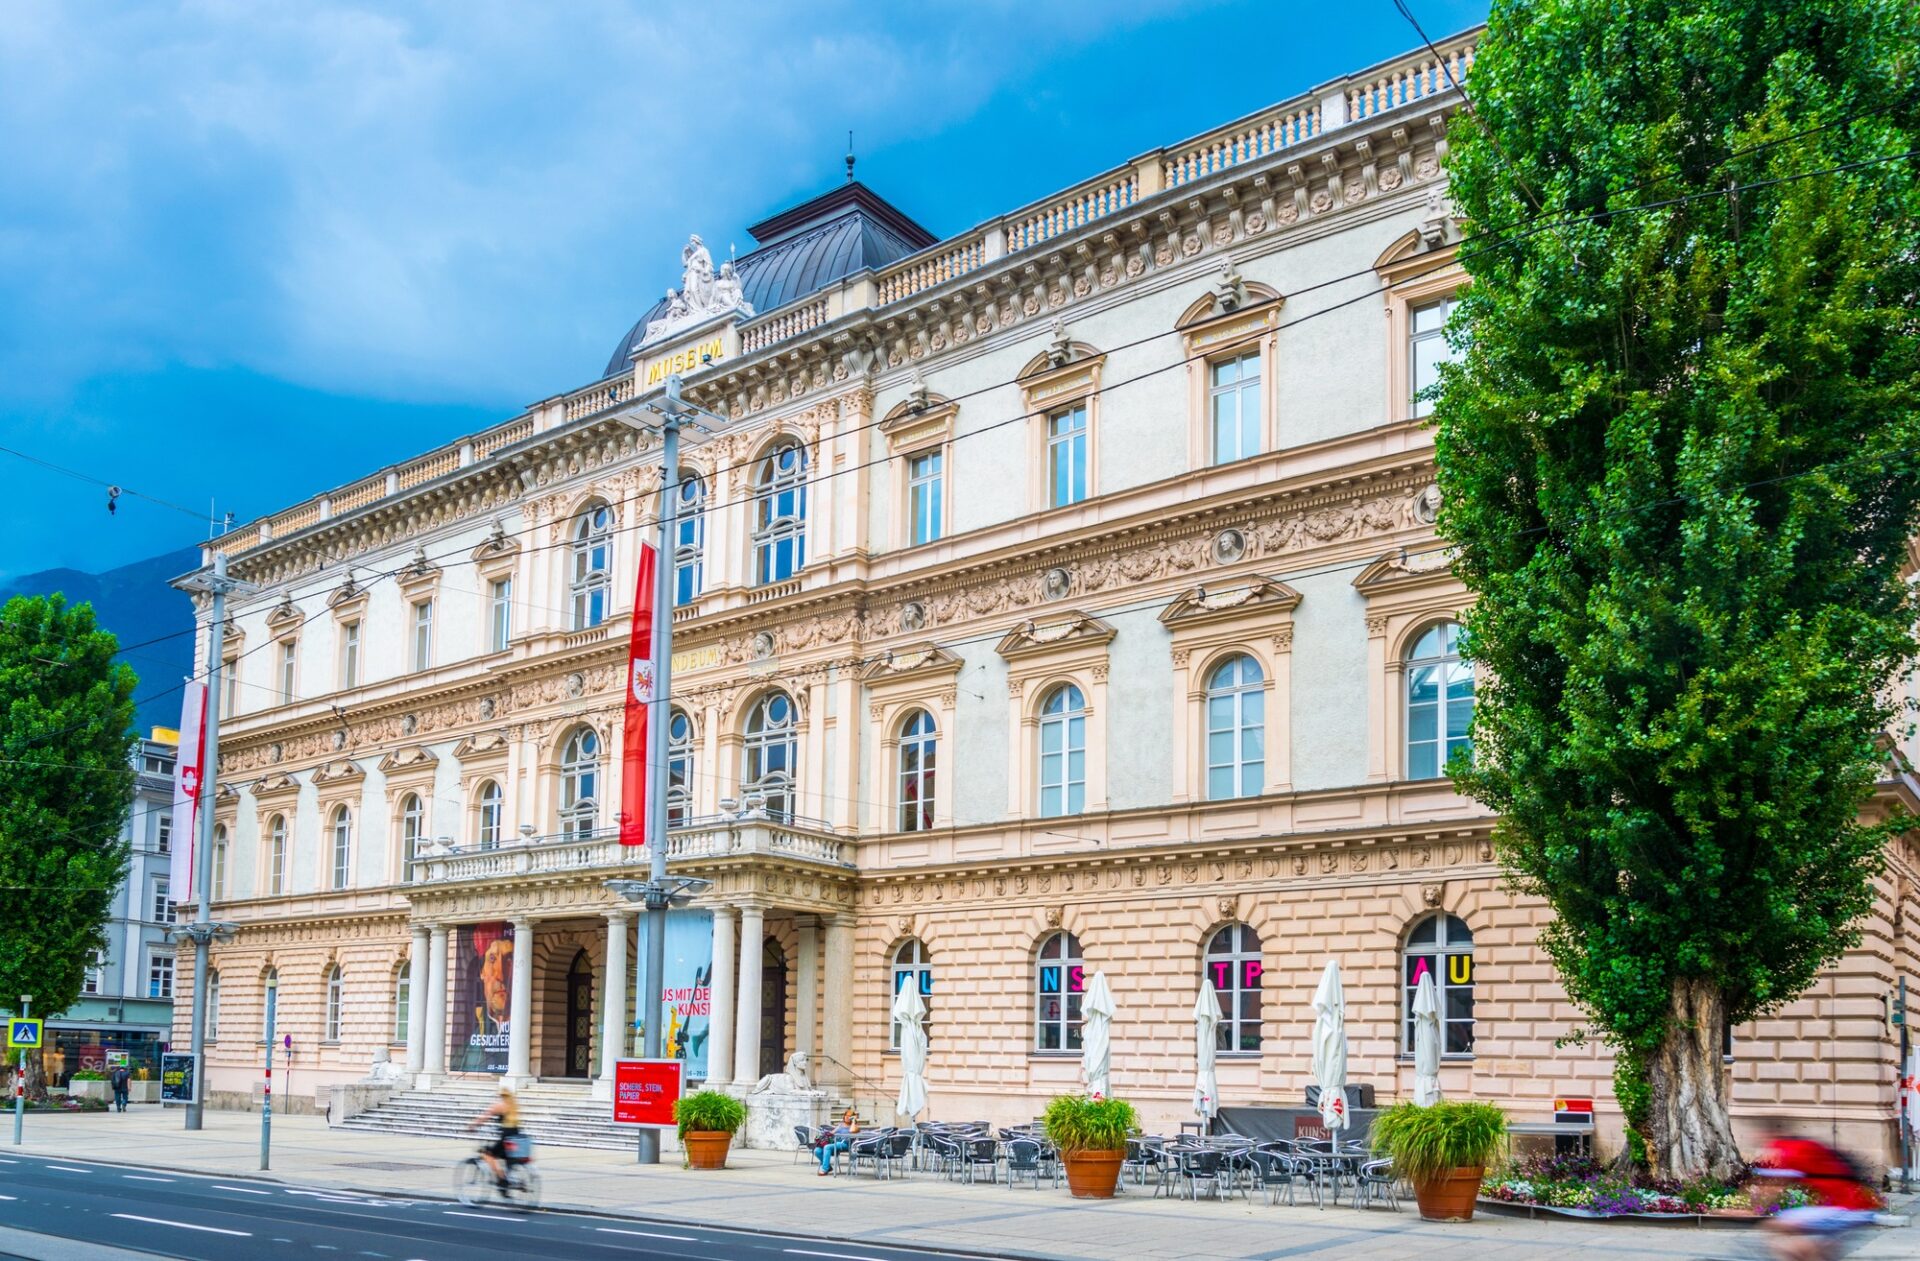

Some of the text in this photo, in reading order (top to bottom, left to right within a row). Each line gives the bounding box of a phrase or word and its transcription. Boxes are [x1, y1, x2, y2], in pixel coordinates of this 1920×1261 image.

[648, 338, 724, 385] MUSEUM
[675, 989, 692, 1001] MIT
[694, 988, 711, 1001] DE
